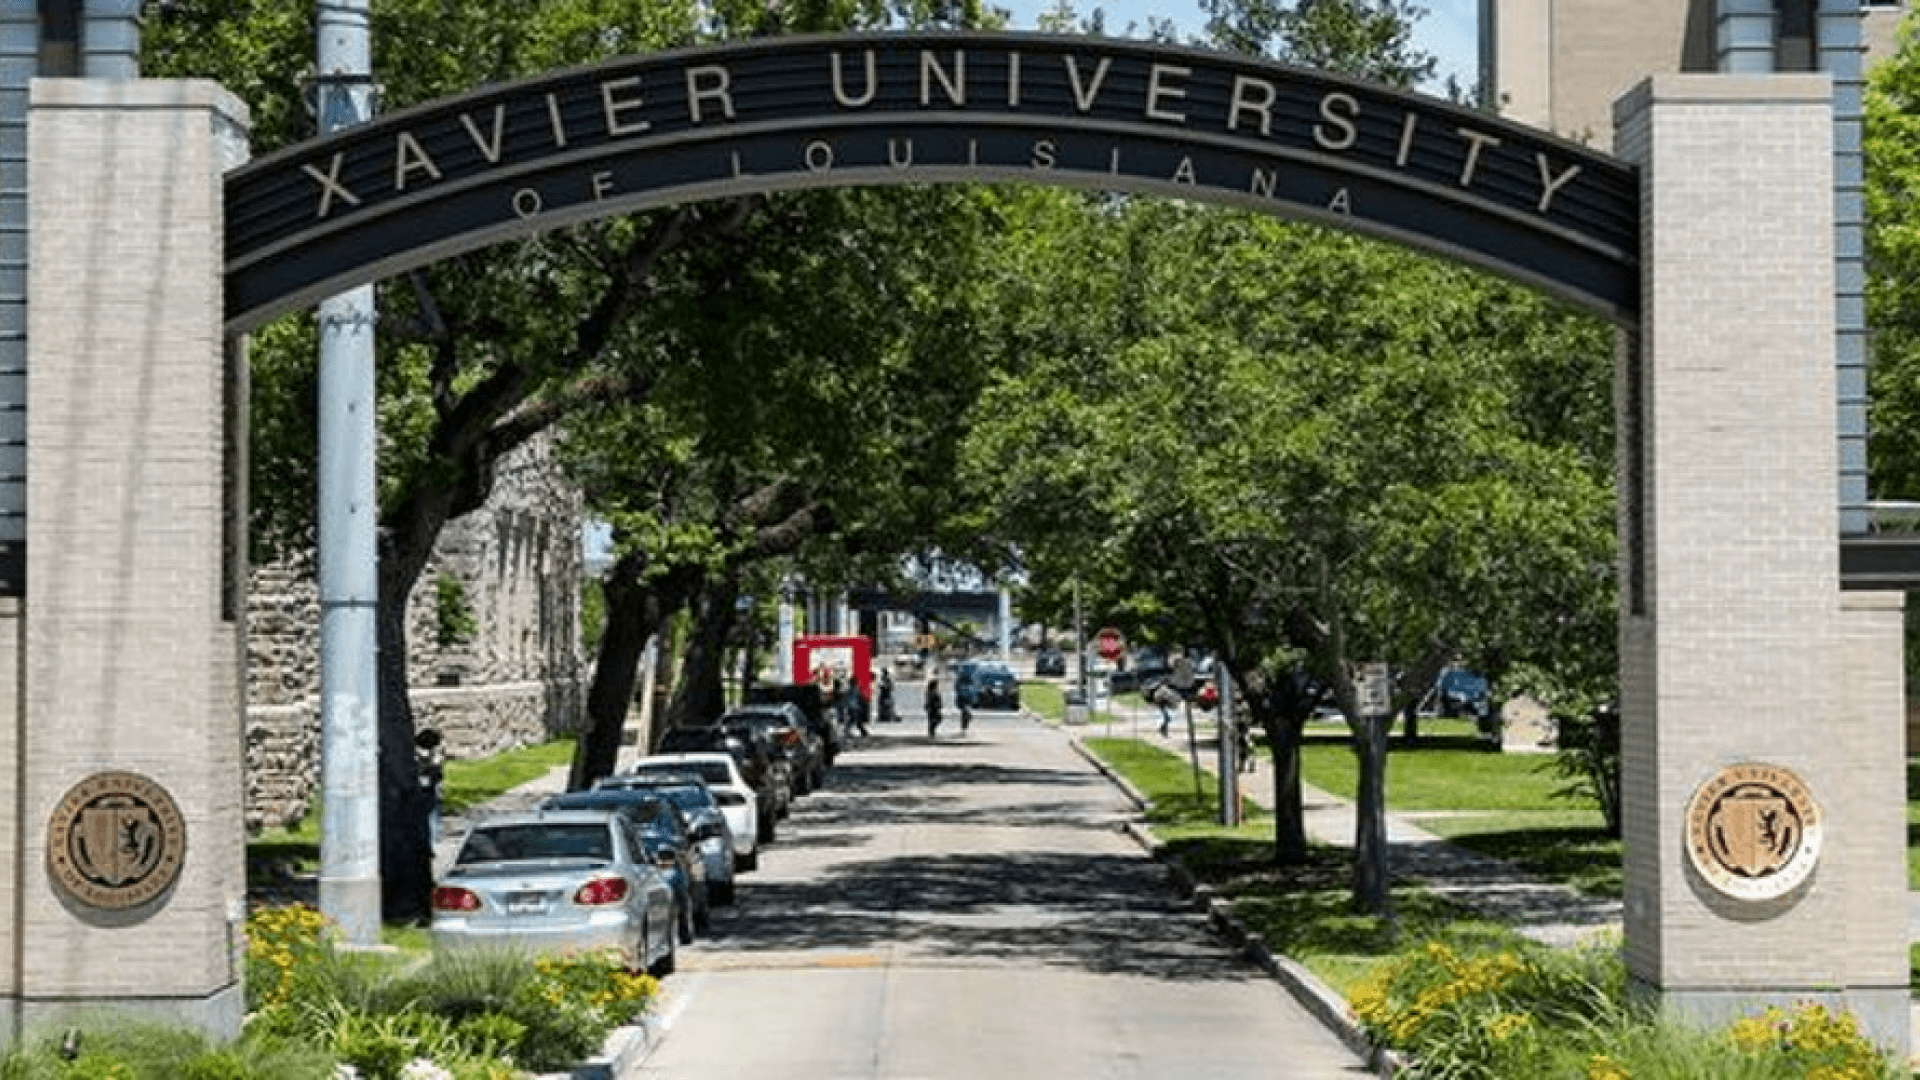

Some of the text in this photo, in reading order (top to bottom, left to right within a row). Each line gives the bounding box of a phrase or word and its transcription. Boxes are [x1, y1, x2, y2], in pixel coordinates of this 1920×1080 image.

[303, 50, 1581, 218] XAVIER UNIVERSITY
[512, 138, 1353, 218] OF LOUISIANA
